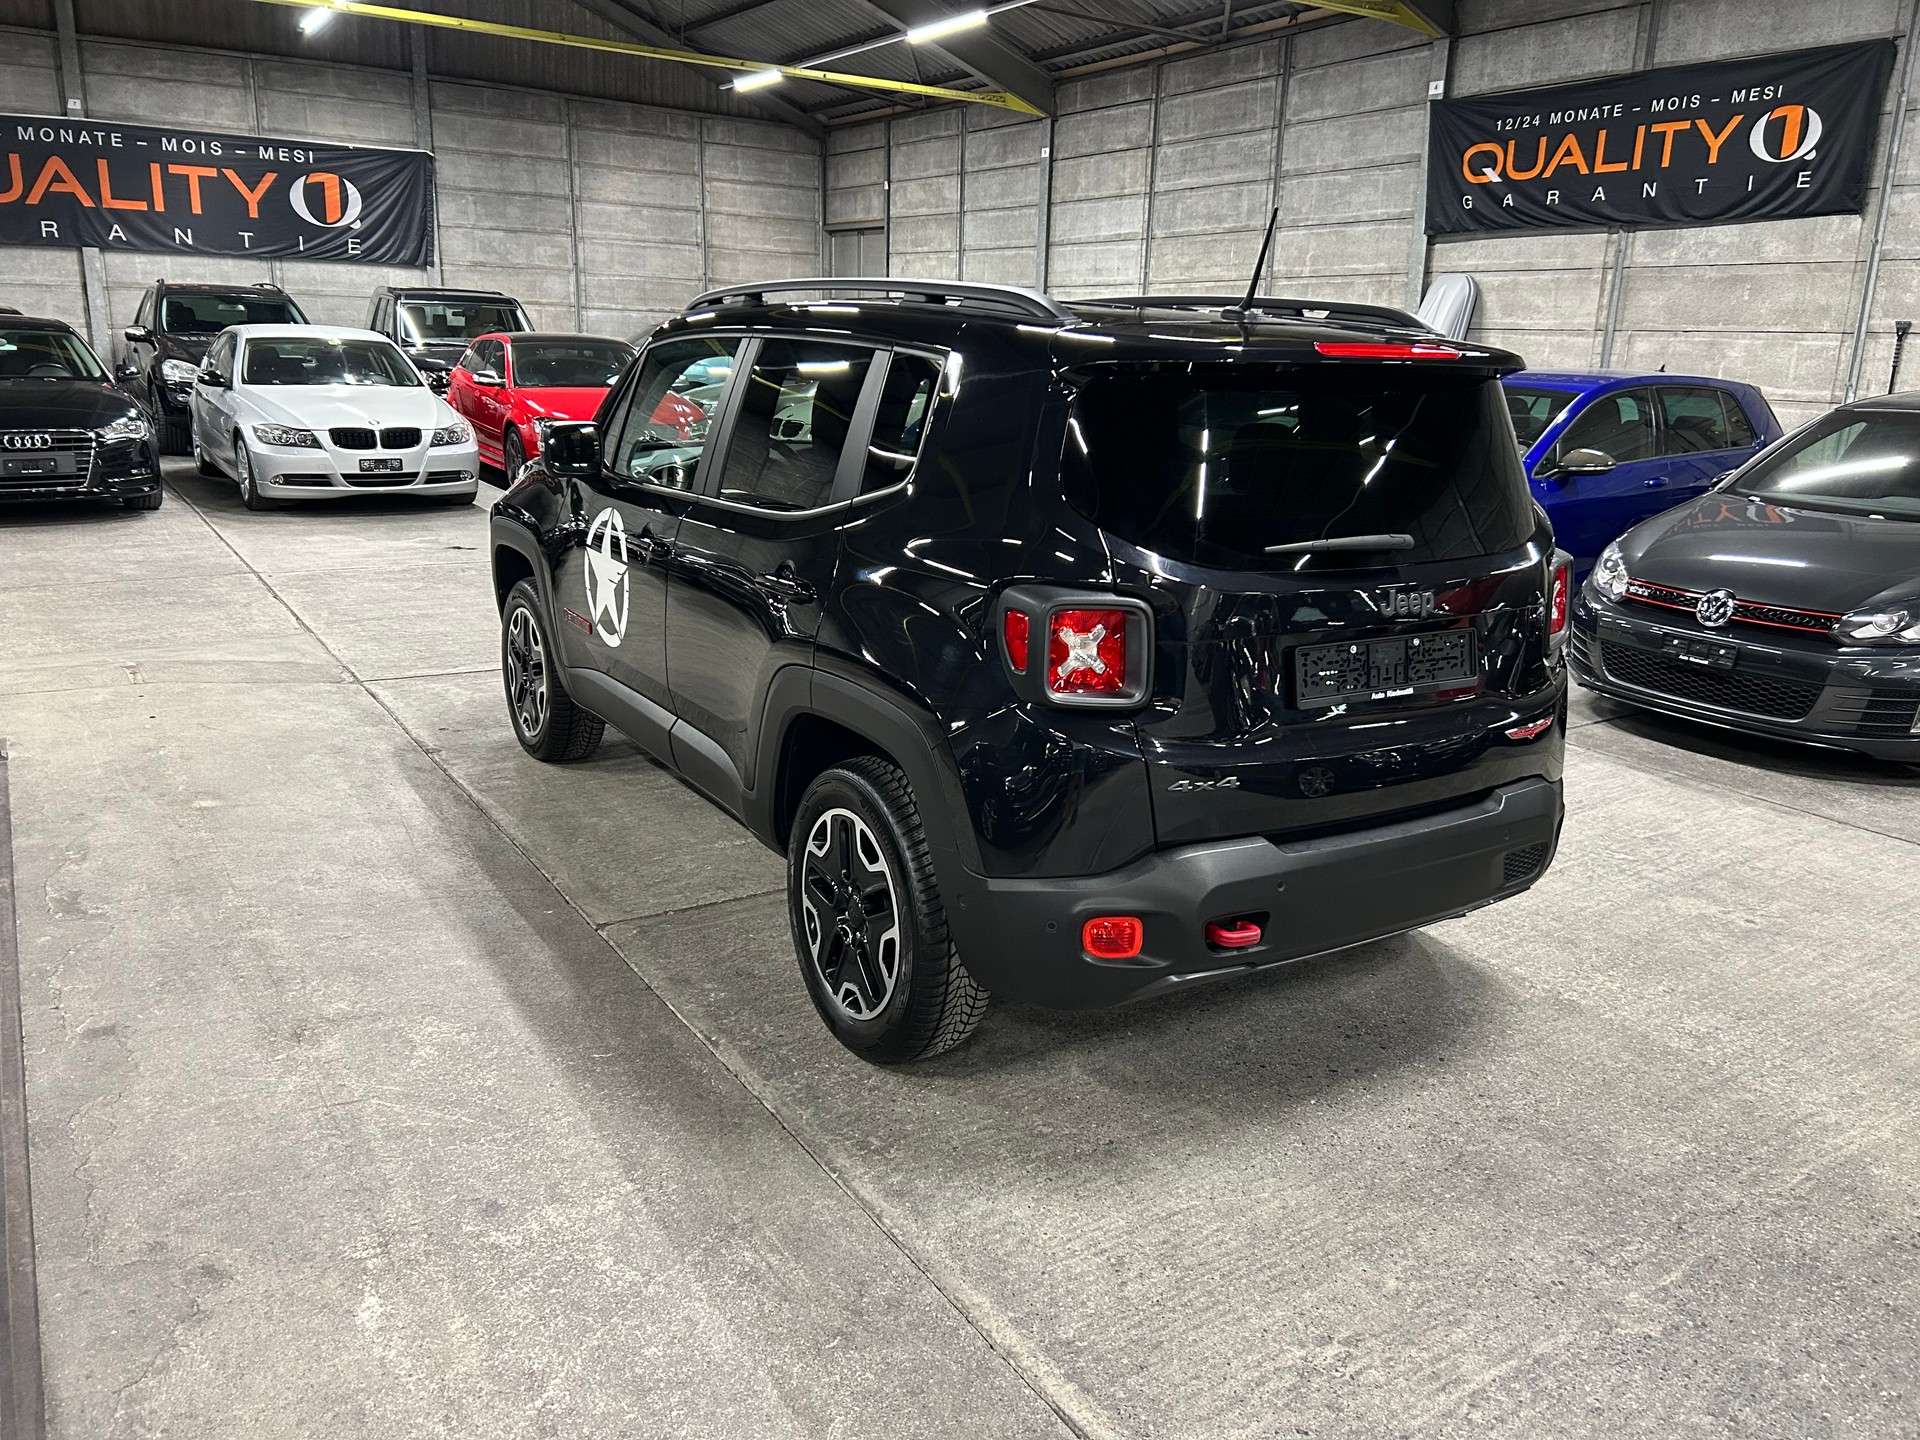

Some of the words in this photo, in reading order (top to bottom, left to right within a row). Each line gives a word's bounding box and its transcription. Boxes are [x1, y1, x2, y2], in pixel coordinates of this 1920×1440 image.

[1496, 114, 1541, 132] 12/24
[1549, 103, 1624, 125] MONATE
[1651, 94, 1701, 113] MOIS
[1731, 84, 1784, 104] MESI
[16, 125, 124, 148] MONATE
[161, 136, 223, 156] MOIS
[259, 145, 314, 164] MESI
[1462, 114, 1745, 184] QUALITY
[1462, 171, 1812, 210] GARANTIE
[1379, 589, 1435, 618] Jeep
[1167, 776, 1241, 793] 4x4
